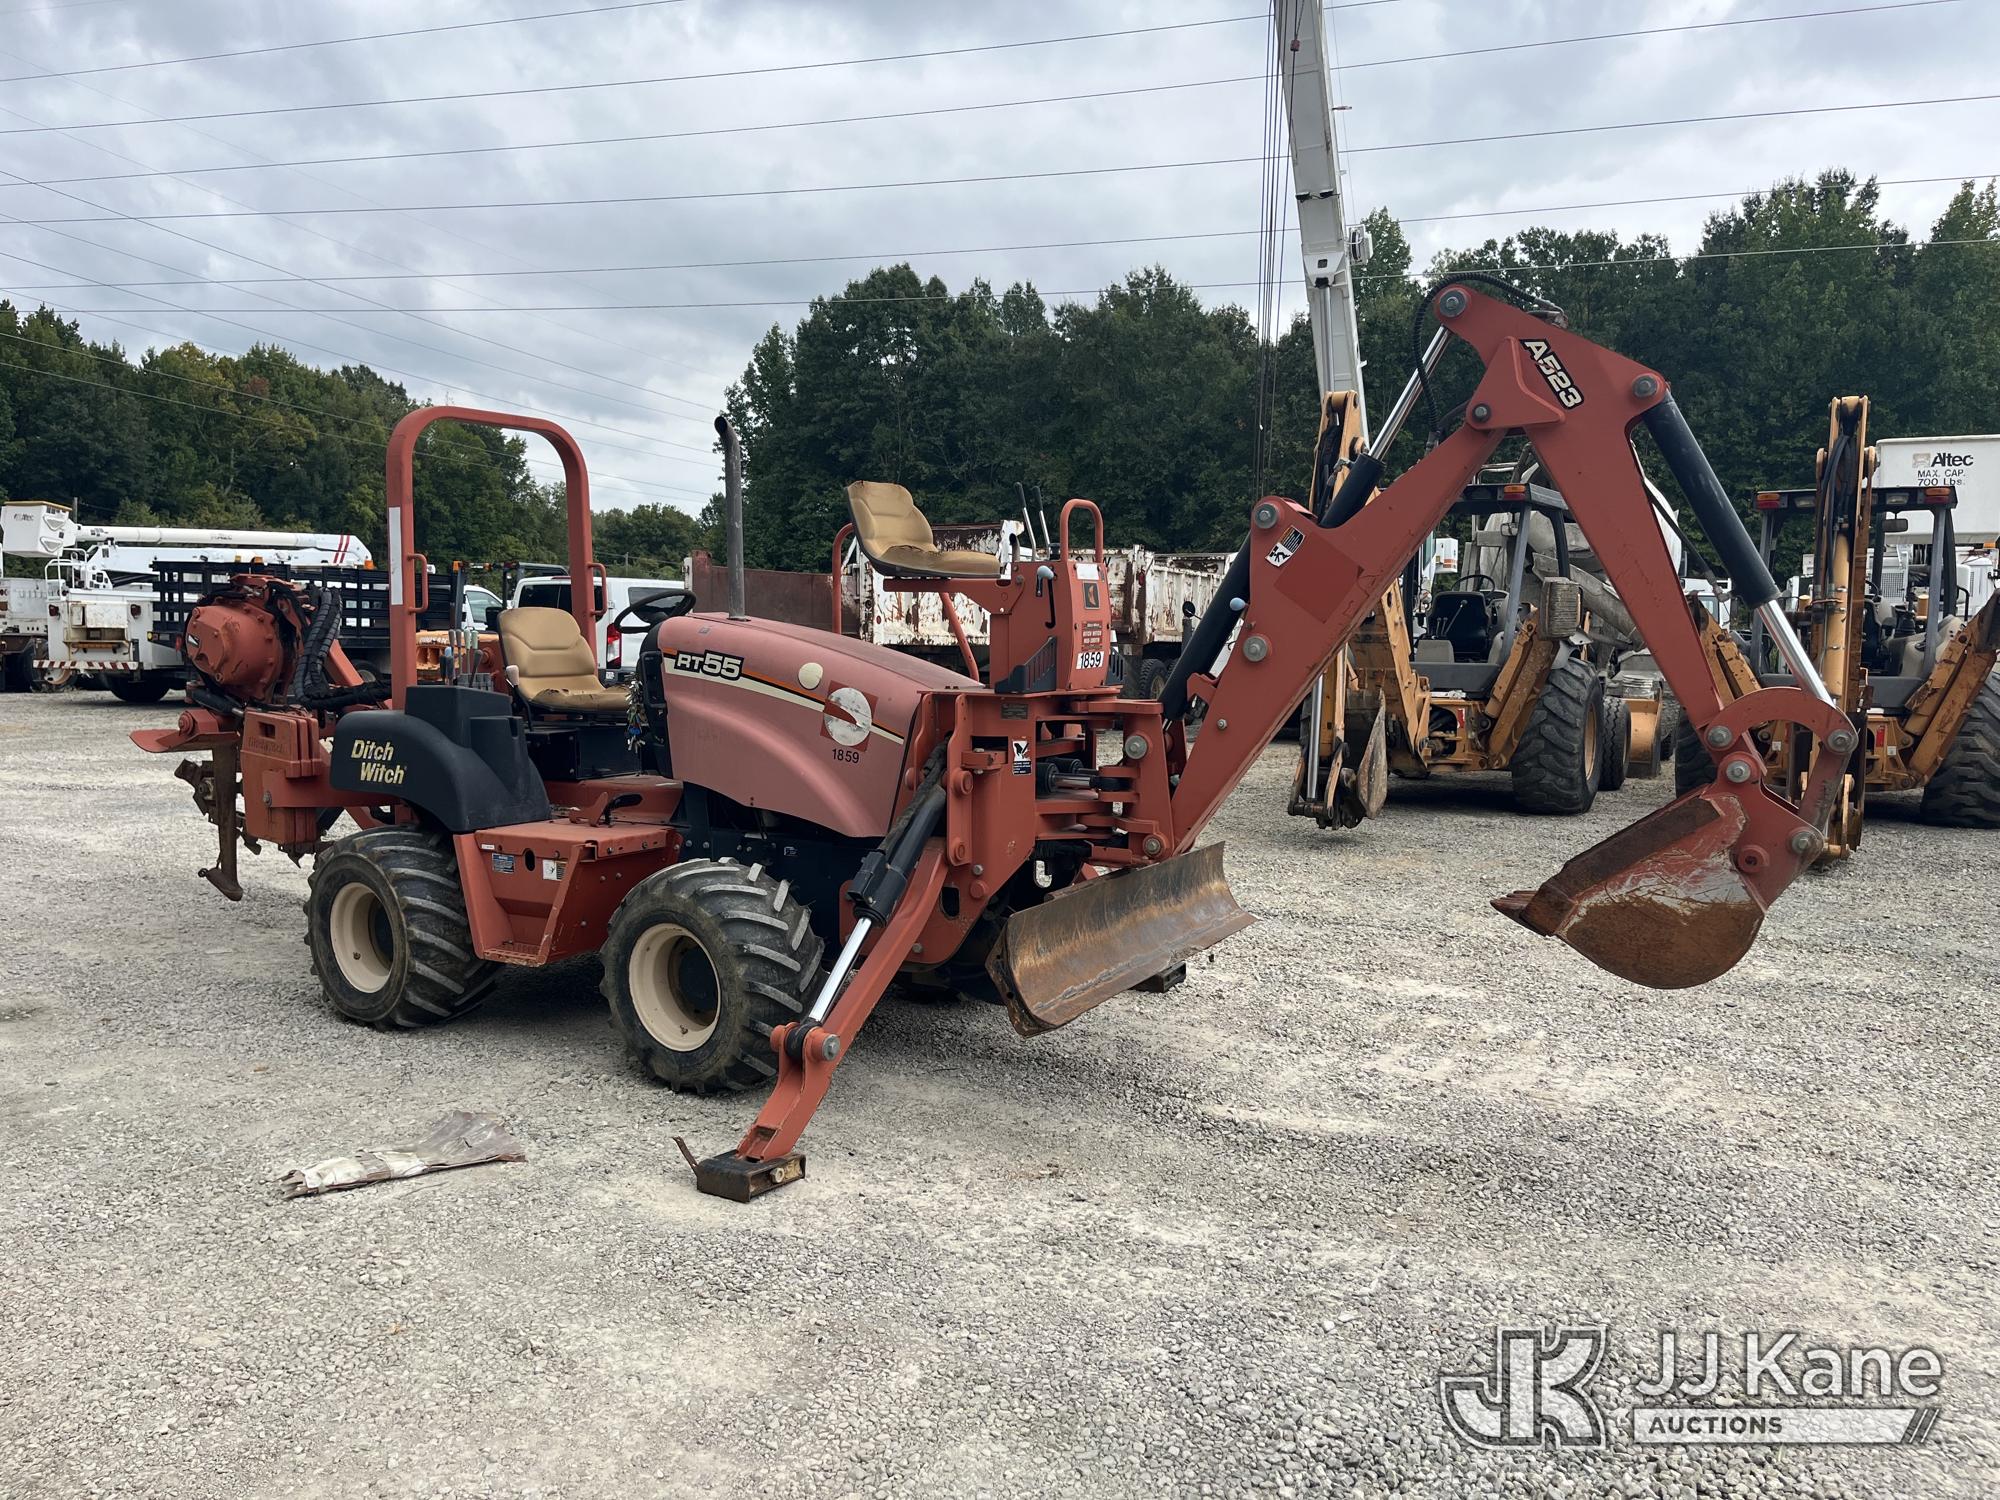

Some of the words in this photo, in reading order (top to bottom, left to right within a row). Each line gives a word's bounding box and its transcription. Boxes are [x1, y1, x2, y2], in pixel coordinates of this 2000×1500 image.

[1523, 340, 1582, 408] A523
[1931, 452, 1974, 468] Altec
[1917, 469, 1941, 478] MAX.
[1944, 469, 1966, 478] CAP.
[1917, 478, 1939, 486] 700
[1943, 478, 1966, 486] Lbs.
[676, 652, 742, 679] RT55
[1080, 651, 1102, 668] 1859
[351, 739, 394, 761] Ditch
[832, 748, 860, 764] 1859
[360, 762, 405, 784] Witch
